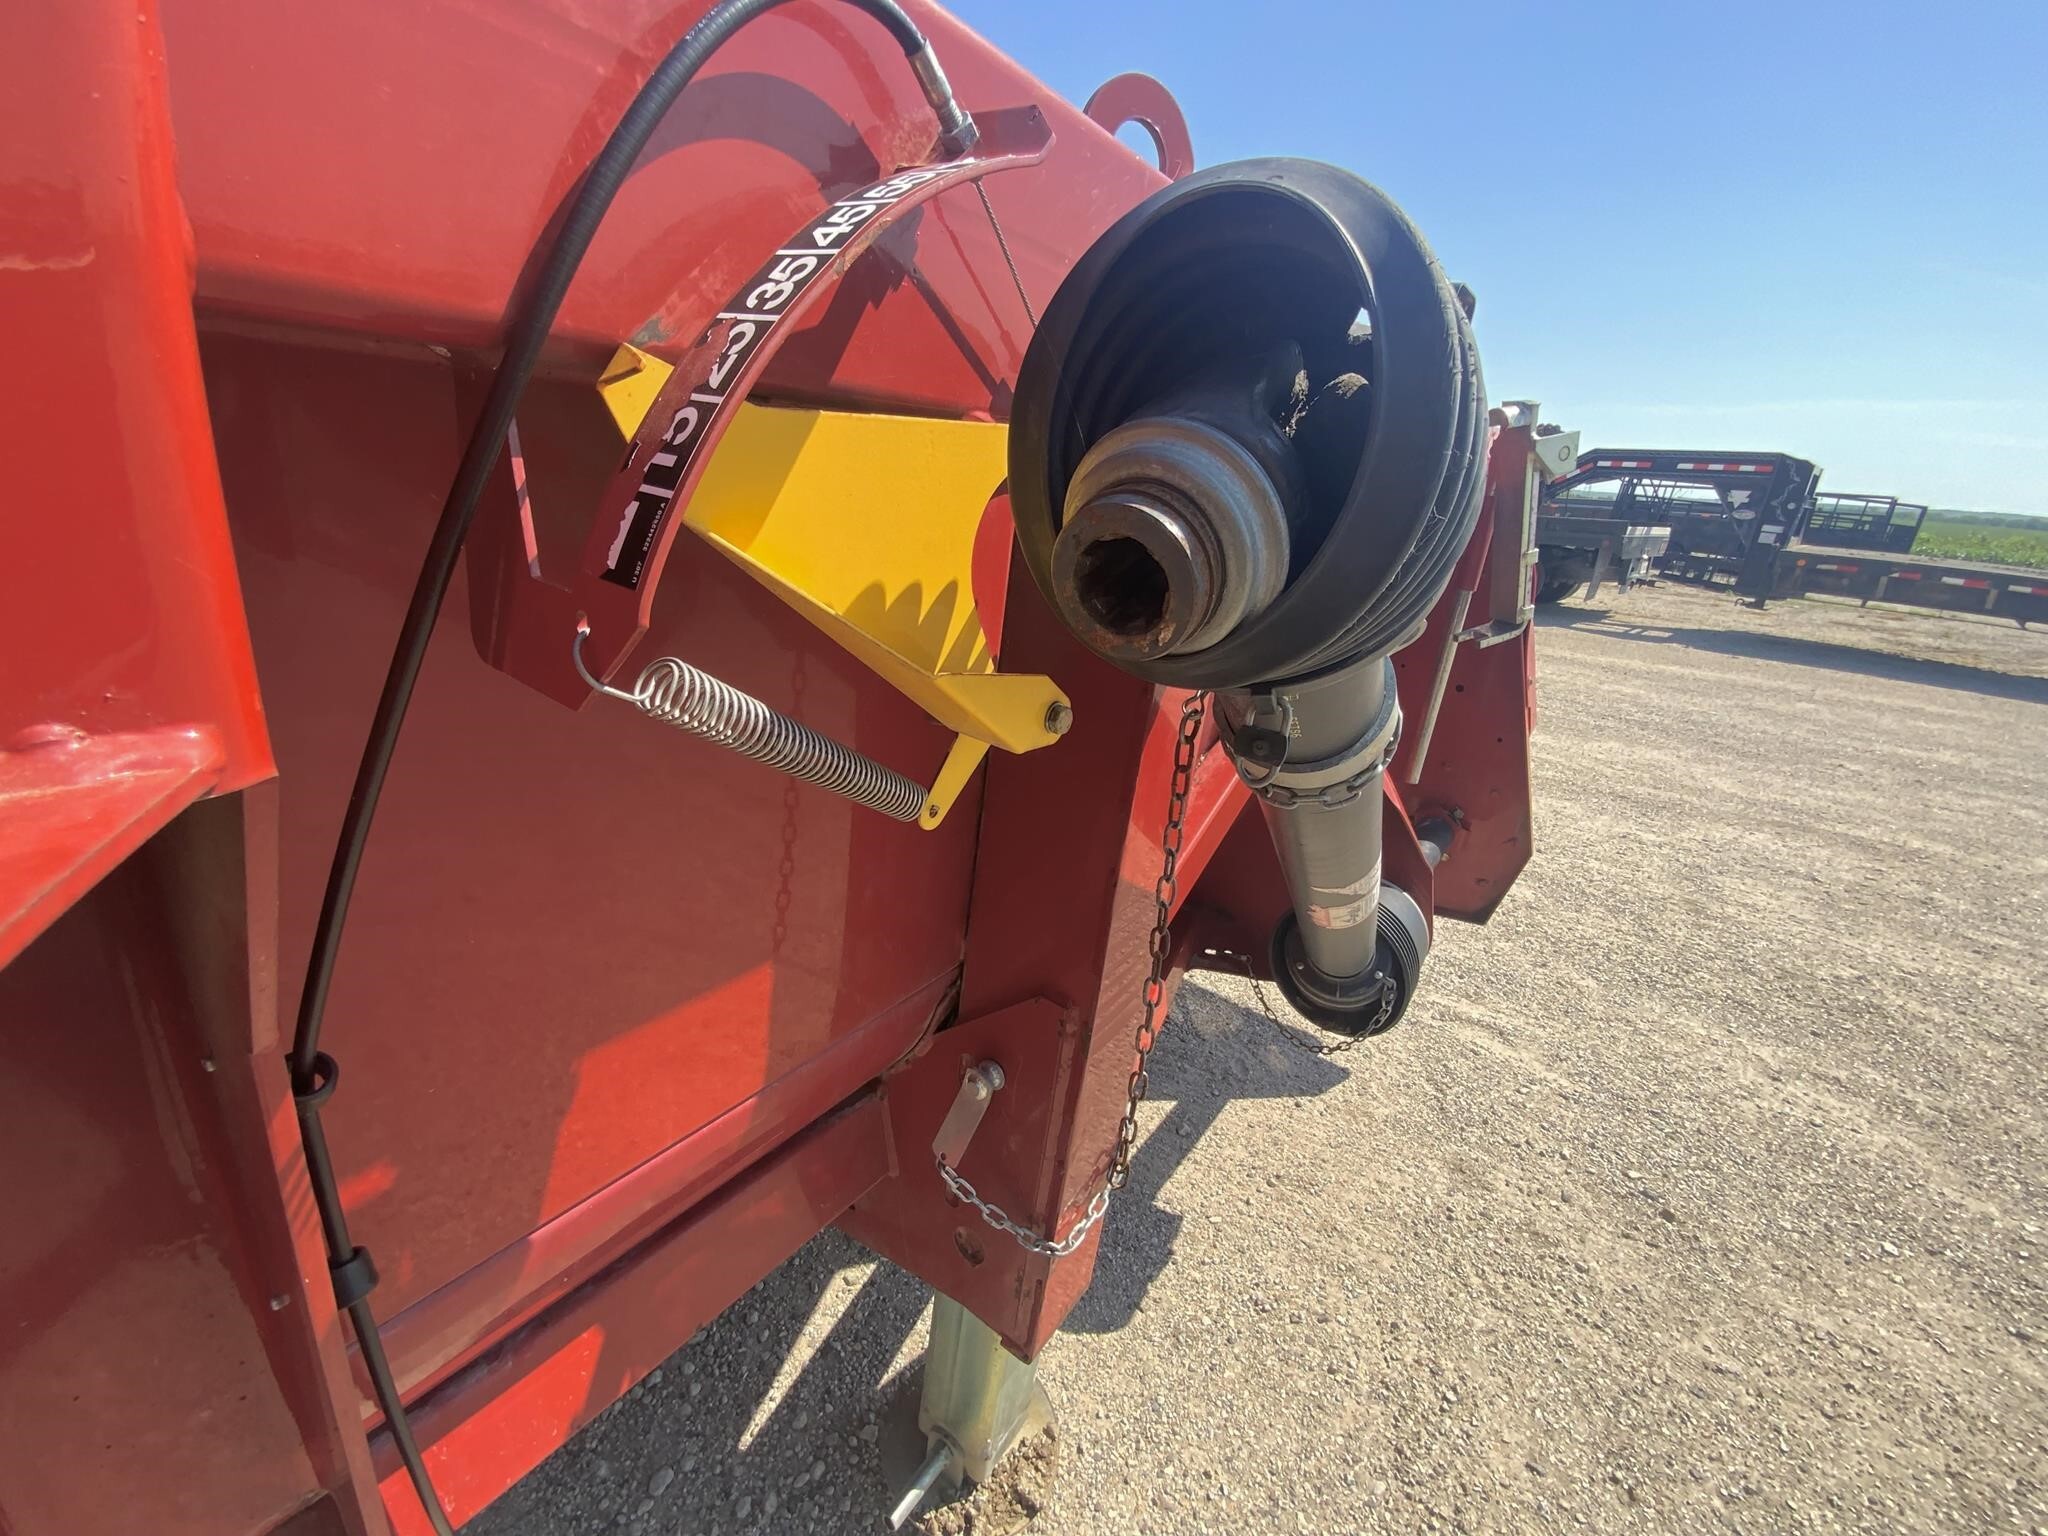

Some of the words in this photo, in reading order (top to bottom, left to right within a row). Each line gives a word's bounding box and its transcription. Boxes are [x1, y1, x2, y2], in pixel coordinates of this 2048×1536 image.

[745, 256, 818, 310] 35
[812, 204, 876, 247] 45
[863, 172, 937, 198] 55
